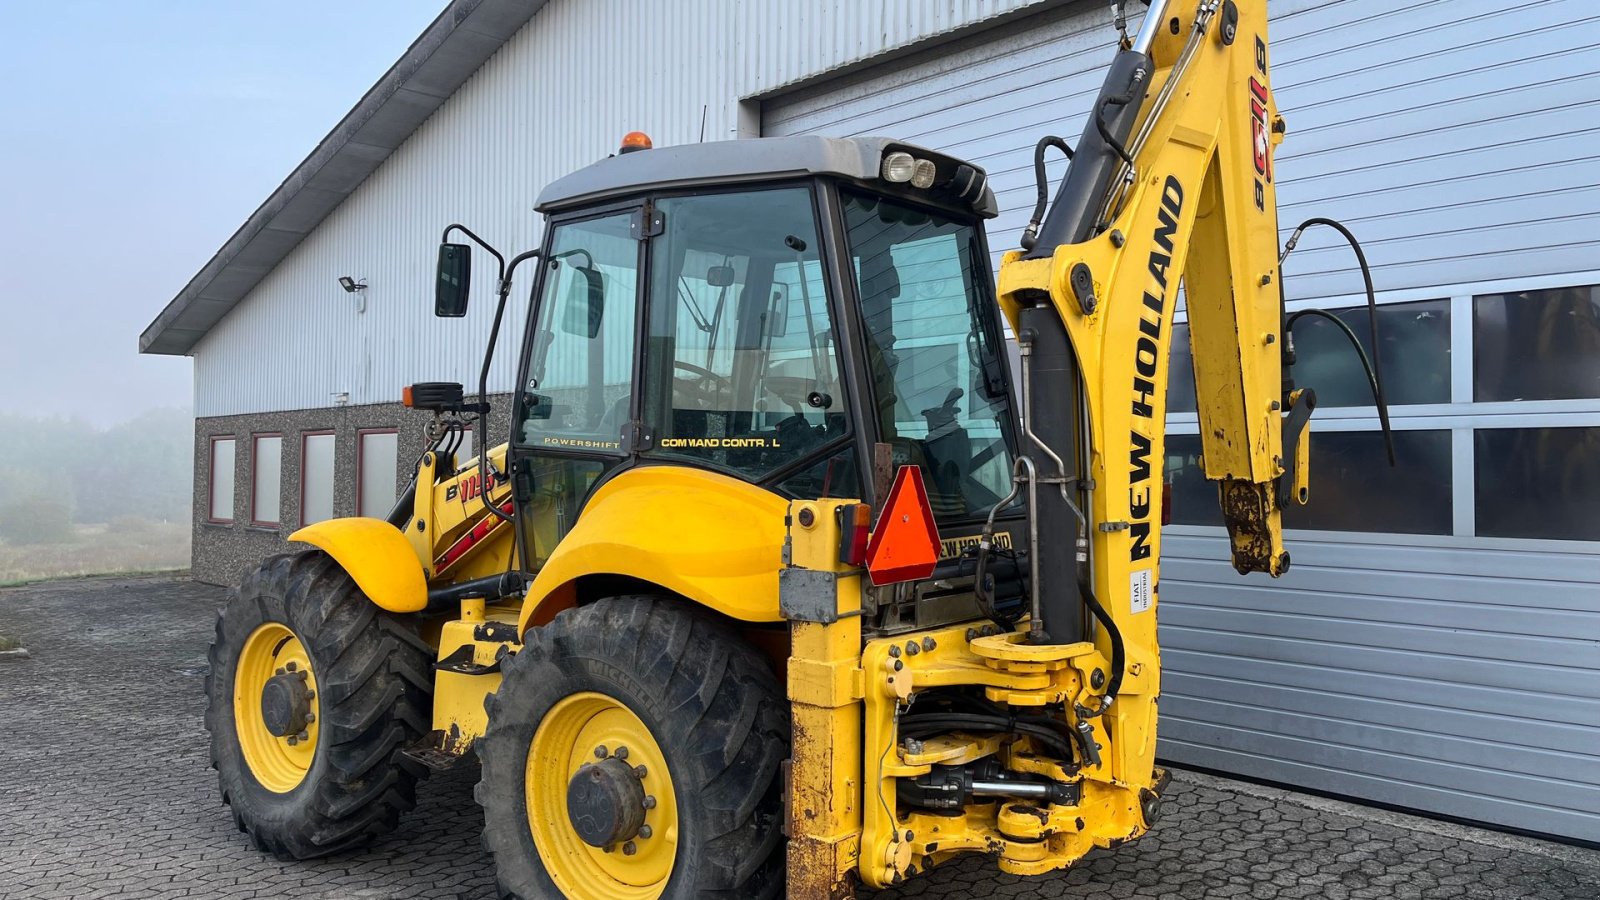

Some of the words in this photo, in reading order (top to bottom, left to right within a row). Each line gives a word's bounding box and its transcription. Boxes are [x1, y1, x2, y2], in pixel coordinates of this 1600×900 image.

[1131, 174, 1184, 419] HOLLAND
[544, 437, 620, 449] POWERSHIFT
[721, 438, 780, 448] CONTRL
[1129, 430, 1152, 562] NEW
[940, 540, 957, 557] EW
